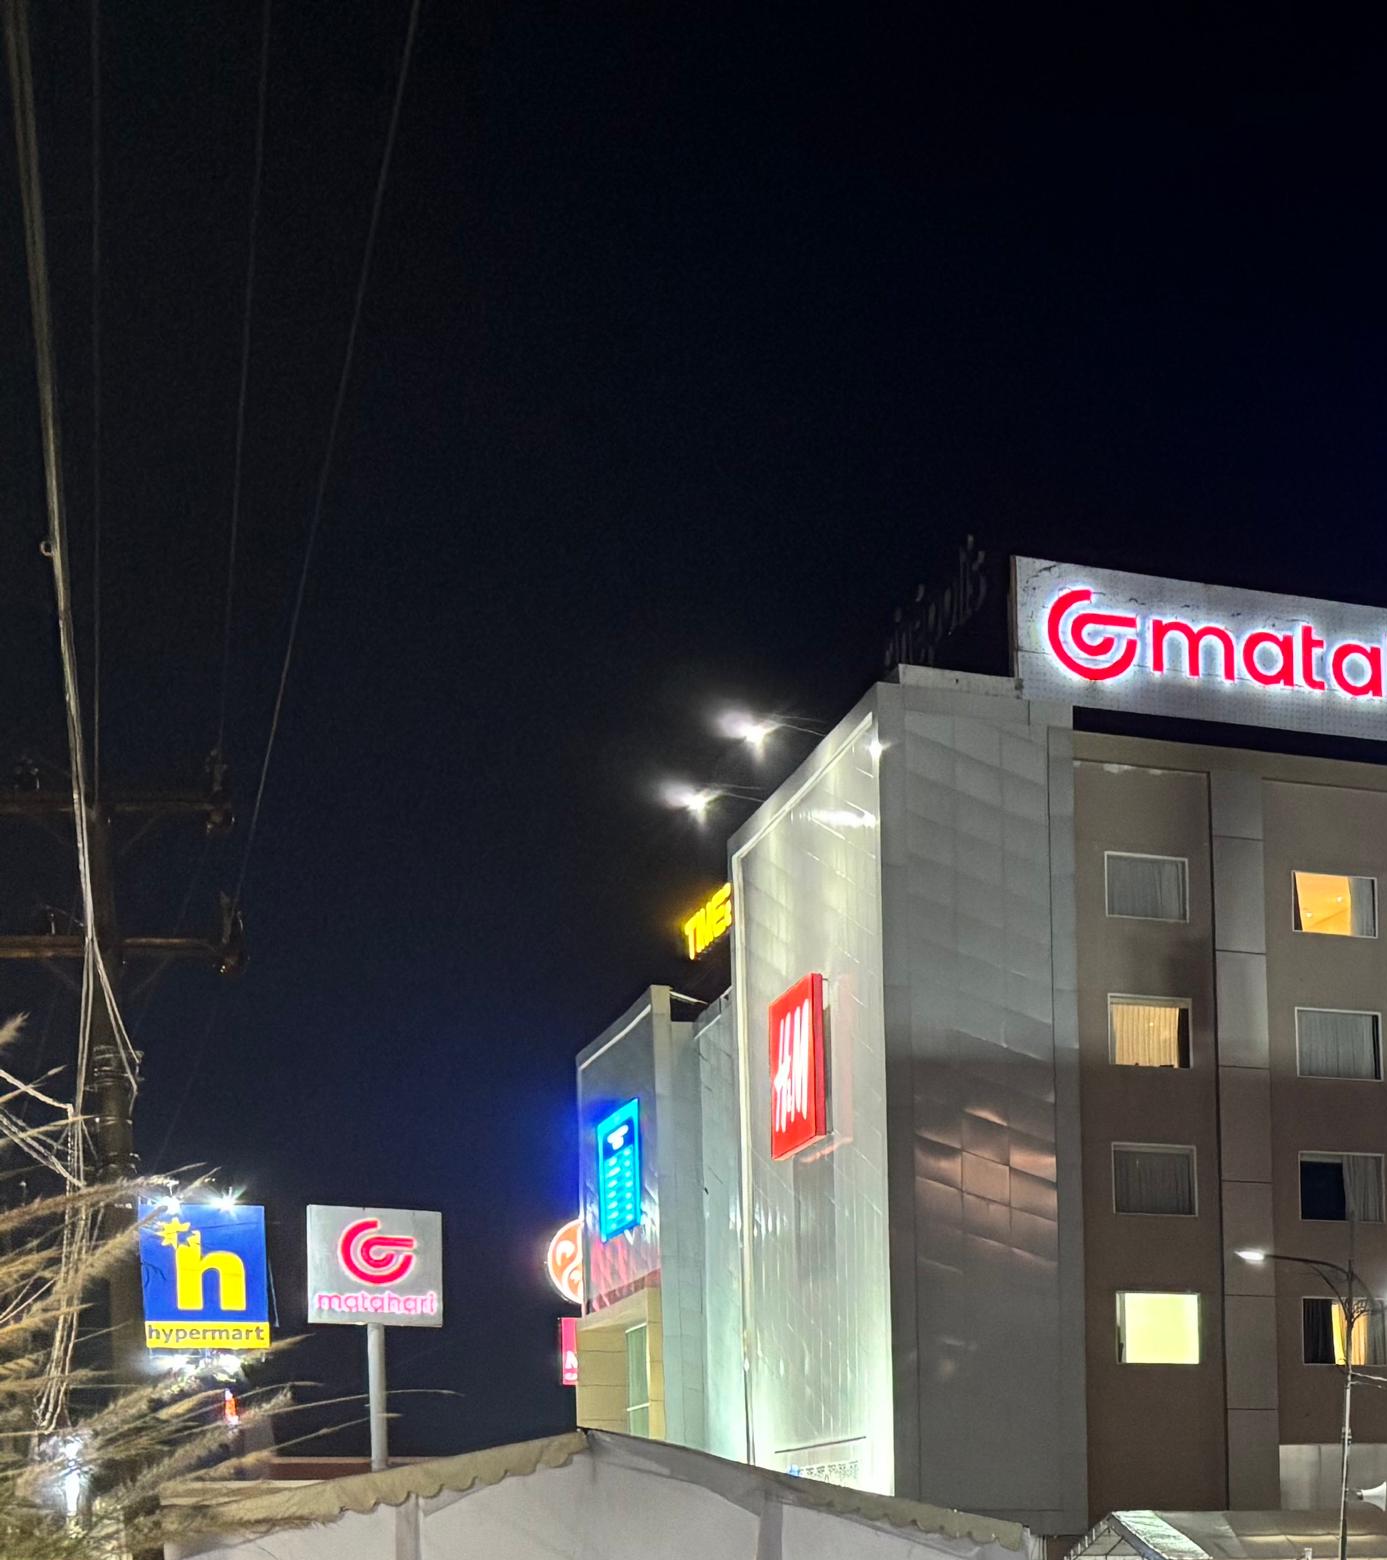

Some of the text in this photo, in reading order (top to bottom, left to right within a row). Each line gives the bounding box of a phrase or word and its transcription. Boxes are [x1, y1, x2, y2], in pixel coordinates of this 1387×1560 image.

[774, 998, 810, 1133] H&M
[315, 1291, 438, 1314] matahari
[148, 1324, 265, 1344] hypermart
